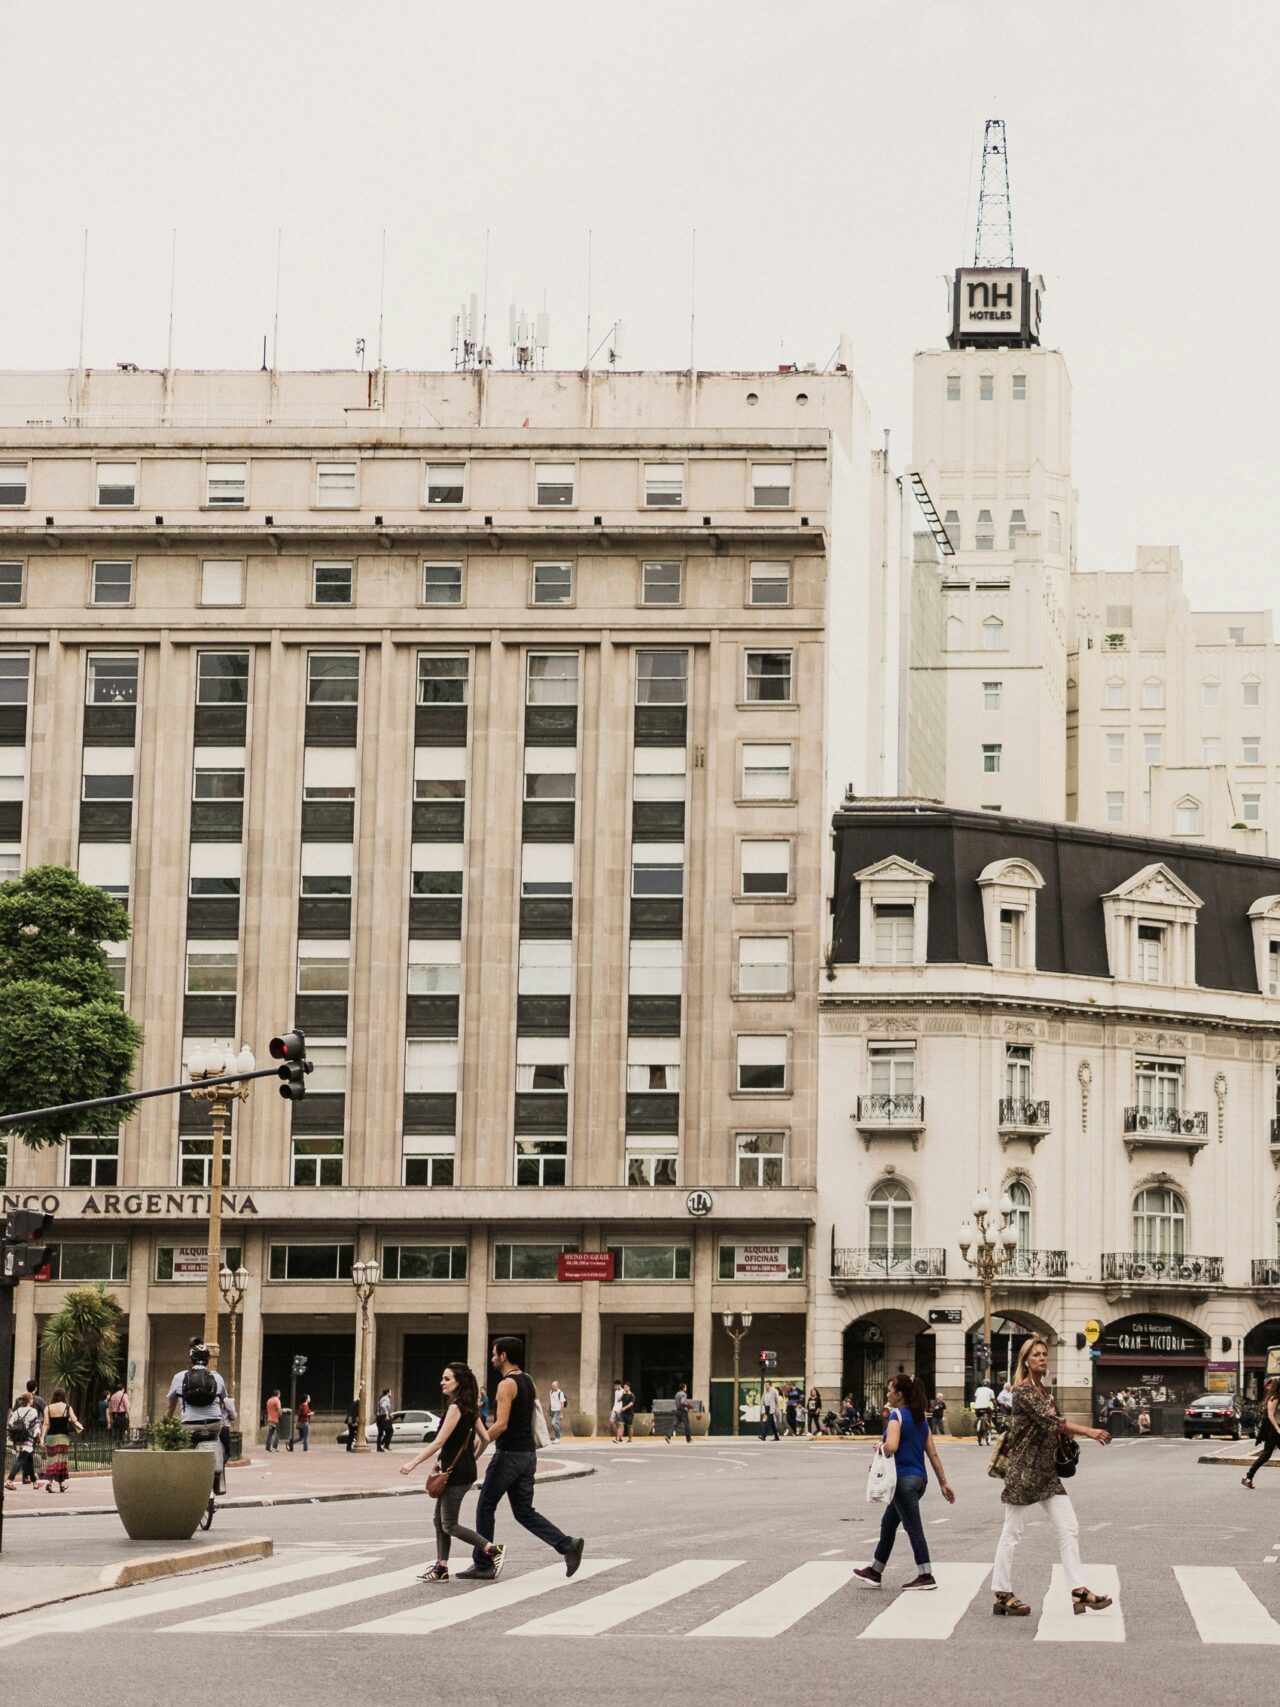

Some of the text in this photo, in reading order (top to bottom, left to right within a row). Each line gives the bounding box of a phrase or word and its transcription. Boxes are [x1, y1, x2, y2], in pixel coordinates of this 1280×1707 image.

[969, 311, 1012, 320] HOTELES
[2, 1194, 258, 1214] NCO ARGENTINA
[179, 1248, 208, 1256] ALQUIL
[744, 1246, 779, 1254] ALQUILER
[1149, 1324, 1172, 1332] Restaurant
[1118, 1334, 1141, 1349] GRAN
